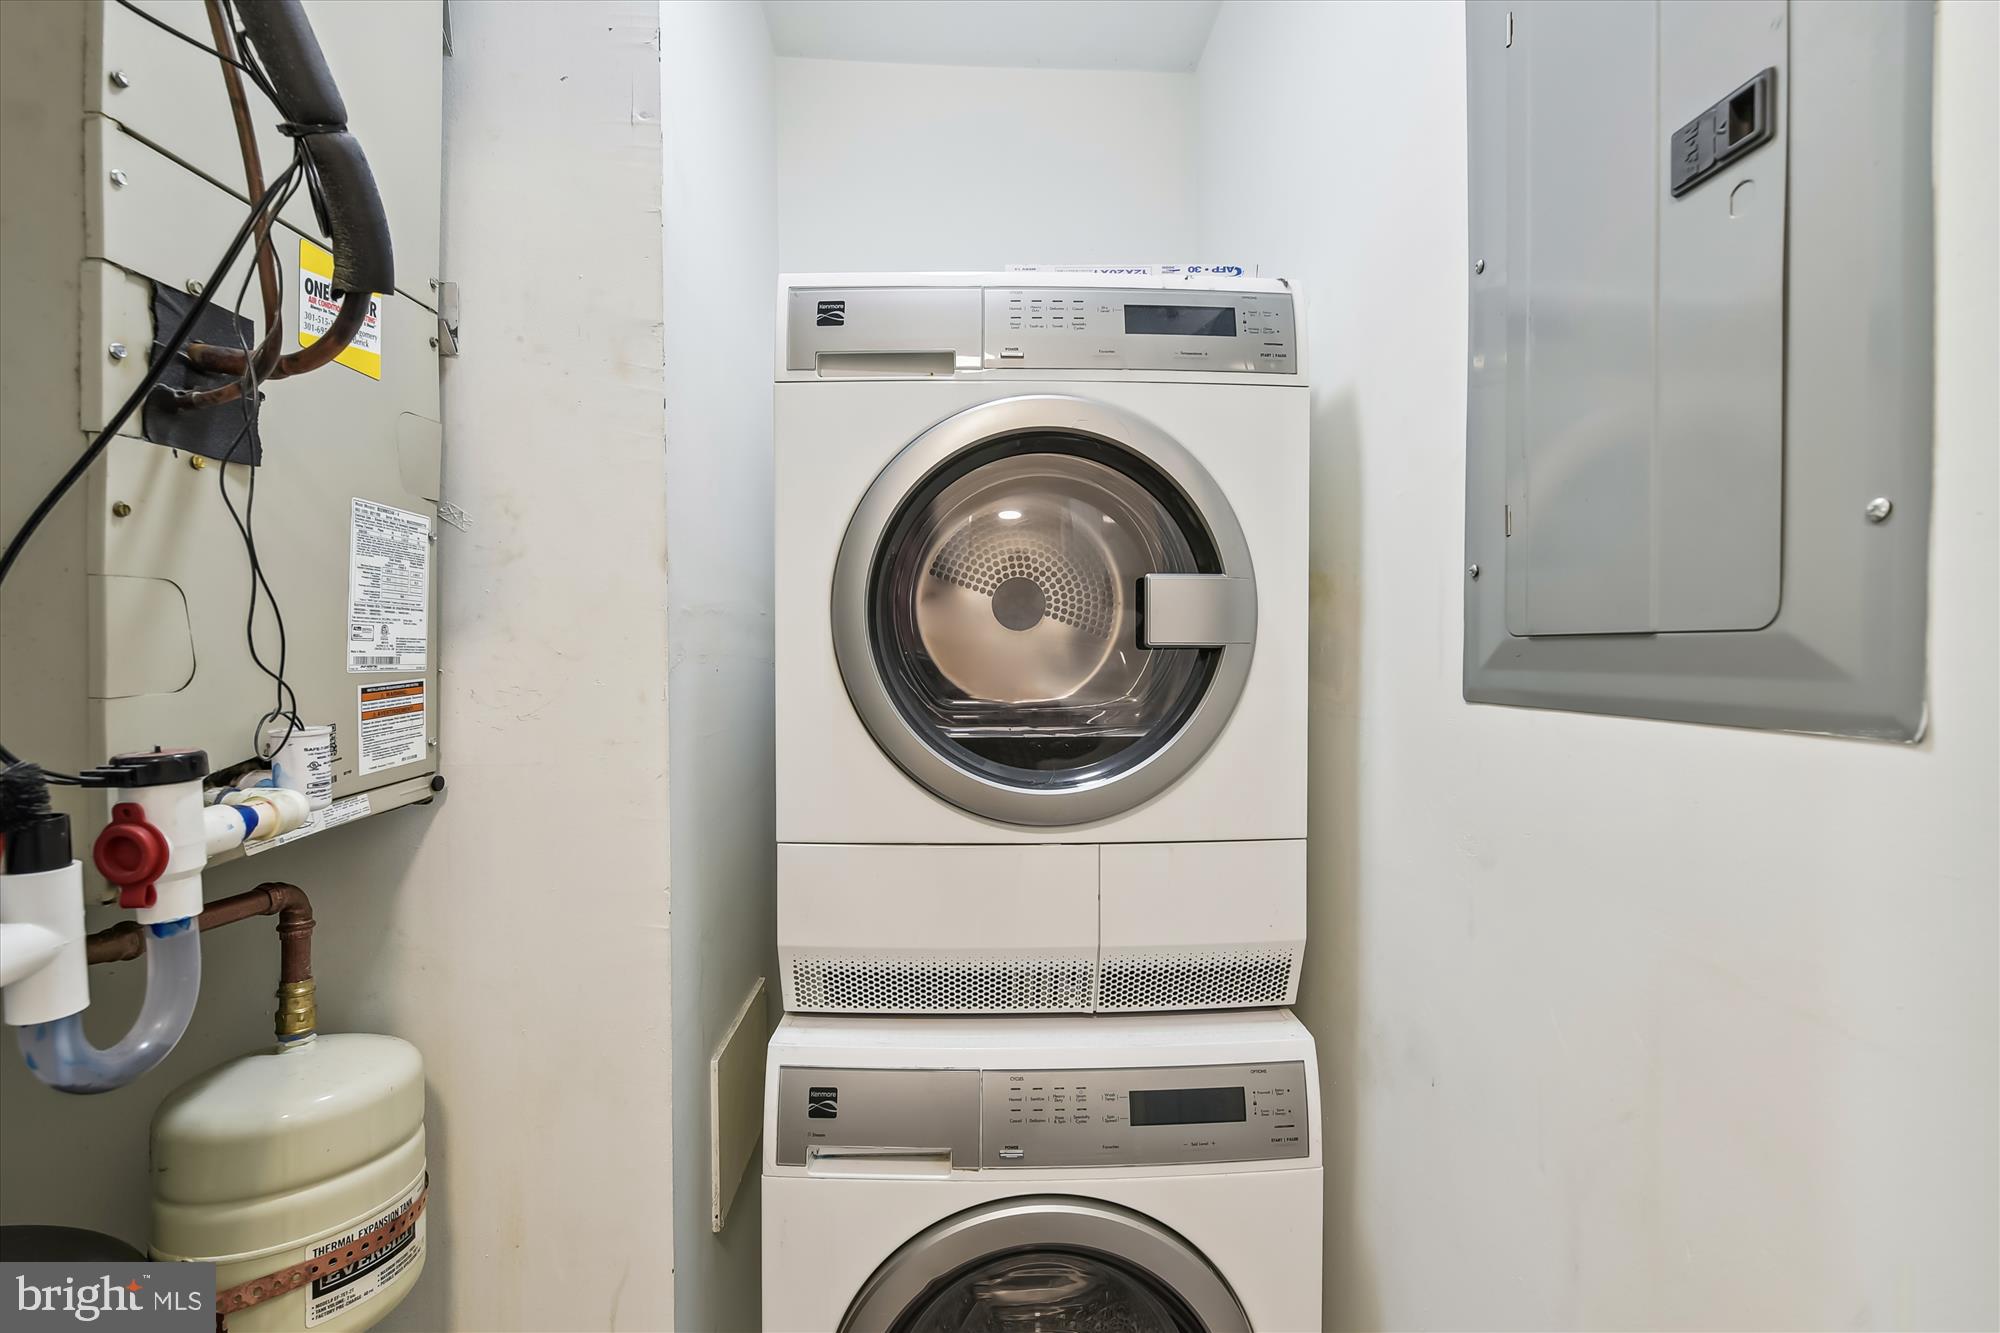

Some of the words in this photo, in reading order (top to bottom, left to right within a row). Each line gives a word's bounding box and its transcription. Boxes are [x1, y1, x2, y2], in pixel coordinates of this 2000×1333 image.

[304, 277, 330, 301] ONE
[312, 1233, 355, 1258] THERMAL
[358, 1208, 399, 1239] EXPANSION
[399, 1197, 413, 1214] TANK
[315, 1306, 327, 1315] TANK
[315, 1308, 335, 1320] FACTORY
